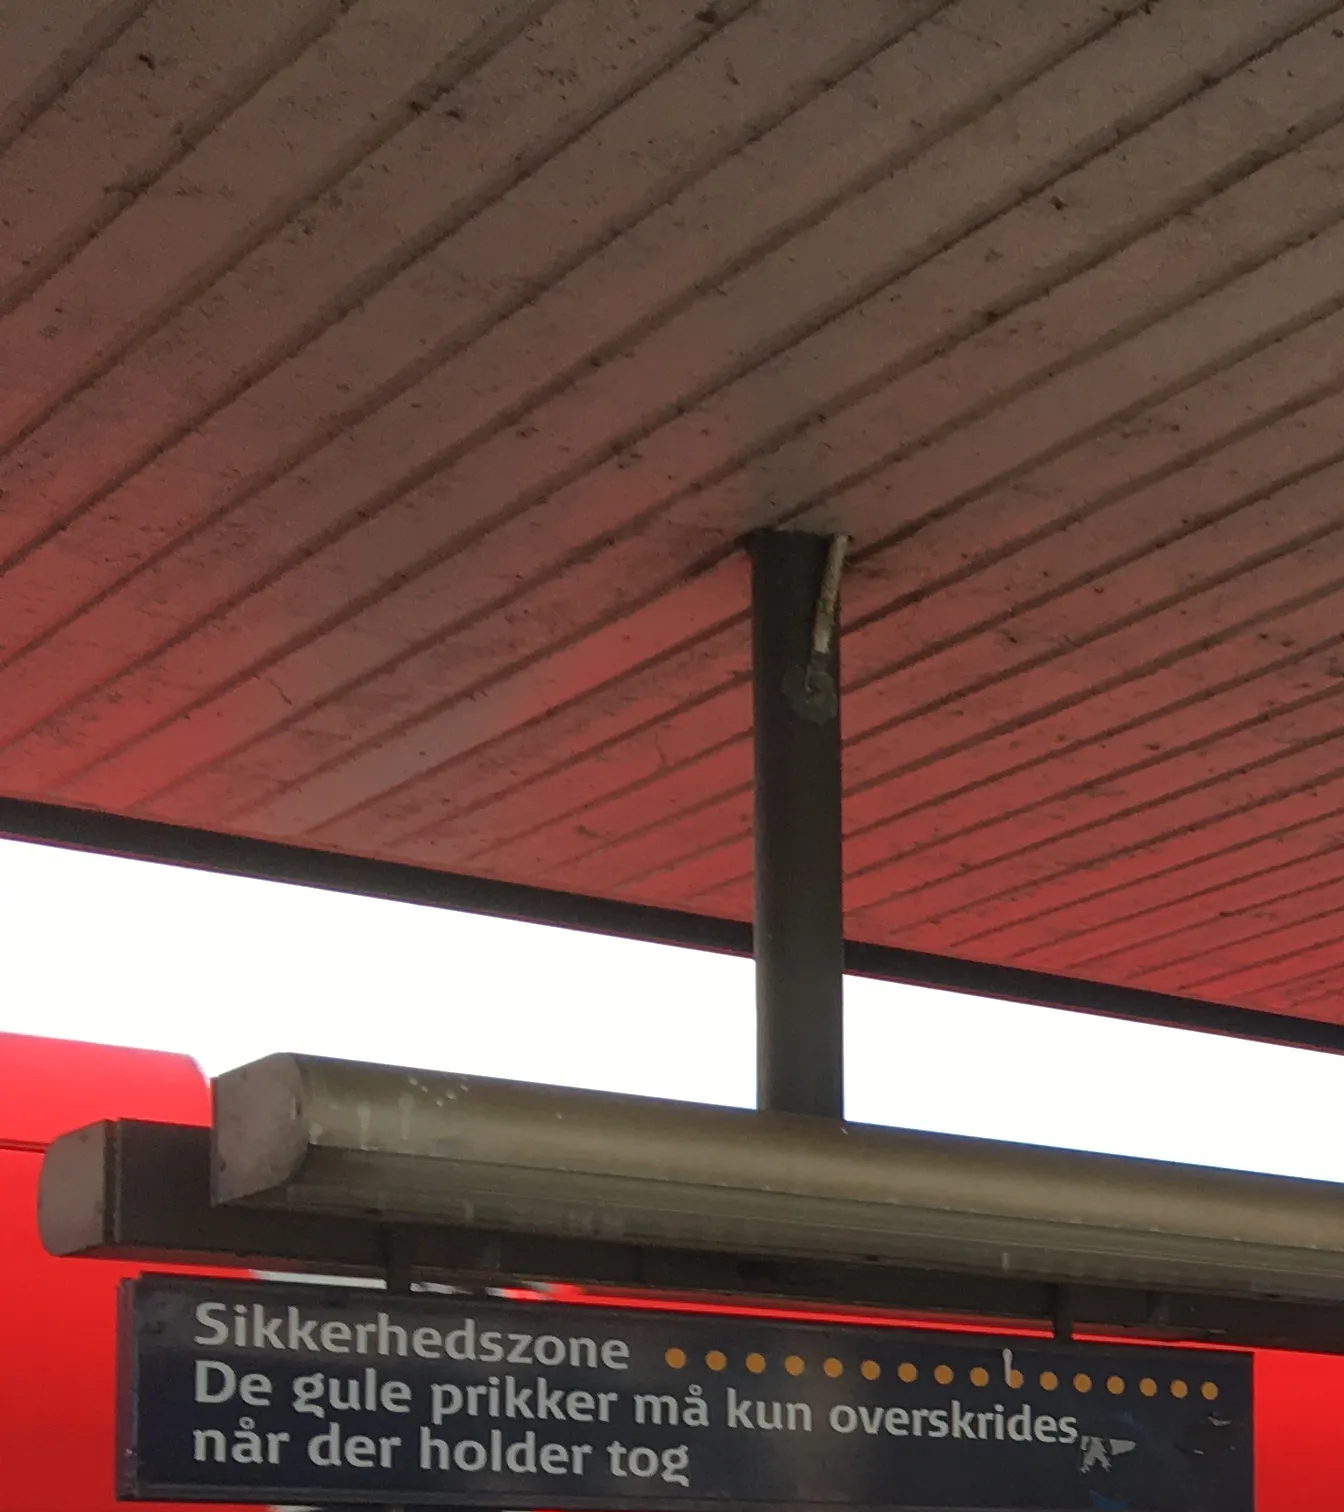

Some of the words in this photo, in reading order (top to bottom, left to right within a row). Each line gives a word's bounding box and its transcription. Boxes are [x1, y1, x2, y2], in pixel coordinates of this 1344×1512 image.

[194, 1302, 631, 1371] Sikkerhedszone
[195, 1360, 272, 1406] De
[292, 1367, 412, 1418] gule
[430, 1375, 619, 1426] prikker
[633, 1384, 711, 1427] må
[727, 1387, 813, 1433] kun
[193, 1416, 290, 1465] når
[308, 1422, 402, 1469] der
[420, 1426, 594, 1476] holder
[606, 1440, 690, 1488] tog
